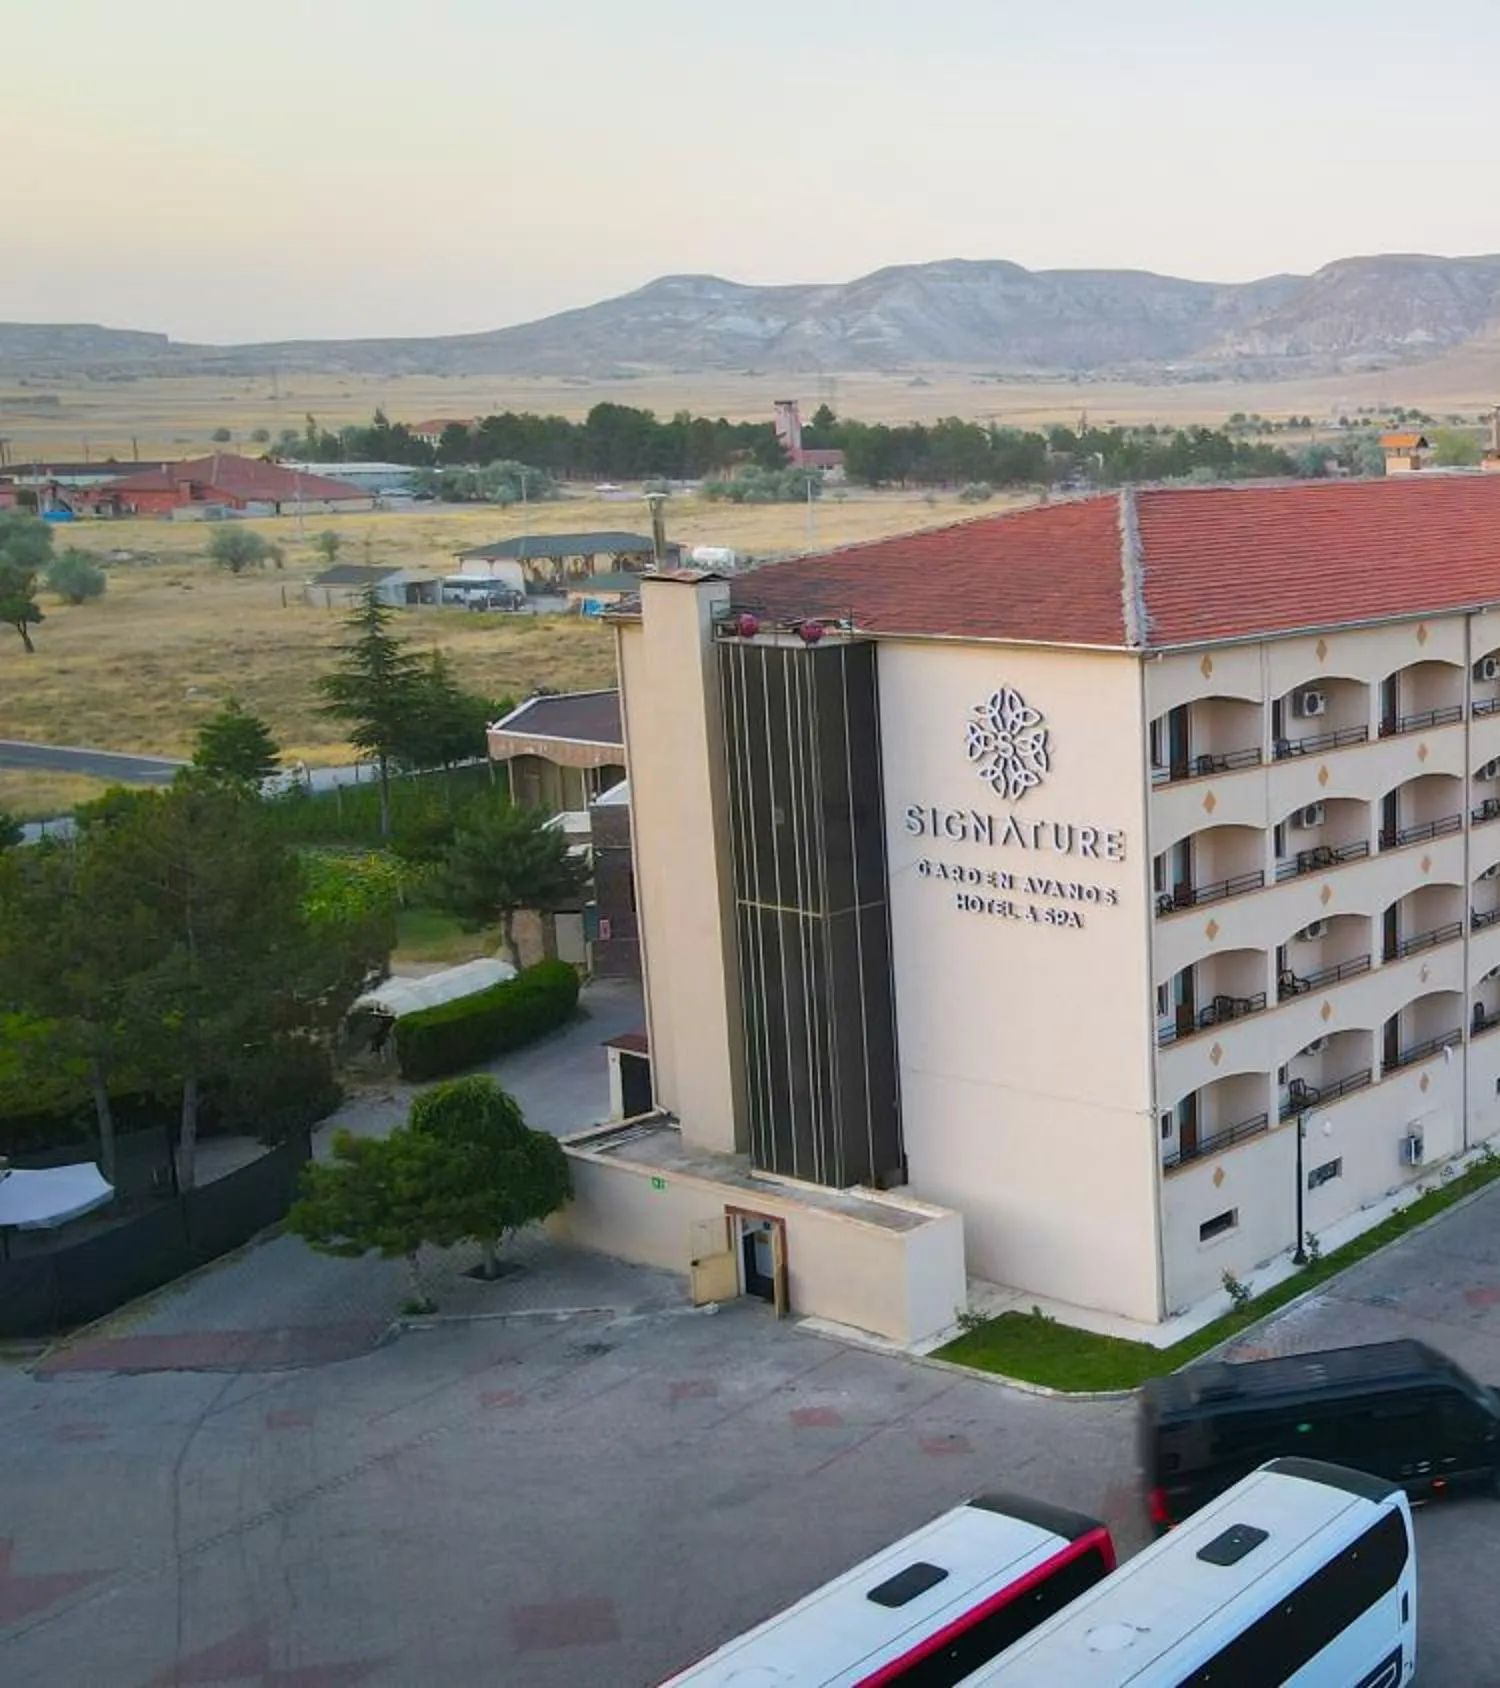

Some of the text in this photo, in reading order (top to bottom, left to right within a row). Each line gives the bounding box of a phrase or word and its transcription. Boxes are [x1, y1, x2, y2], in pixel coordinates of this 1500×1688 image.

[905, 804, 1127, 862] SIGNATURE
[918, 858, 1120, 907] GARDEN AVANOS
[956, 892, 1020, 919] HOTEL
[1044, 907, 1085, 929] SPA
